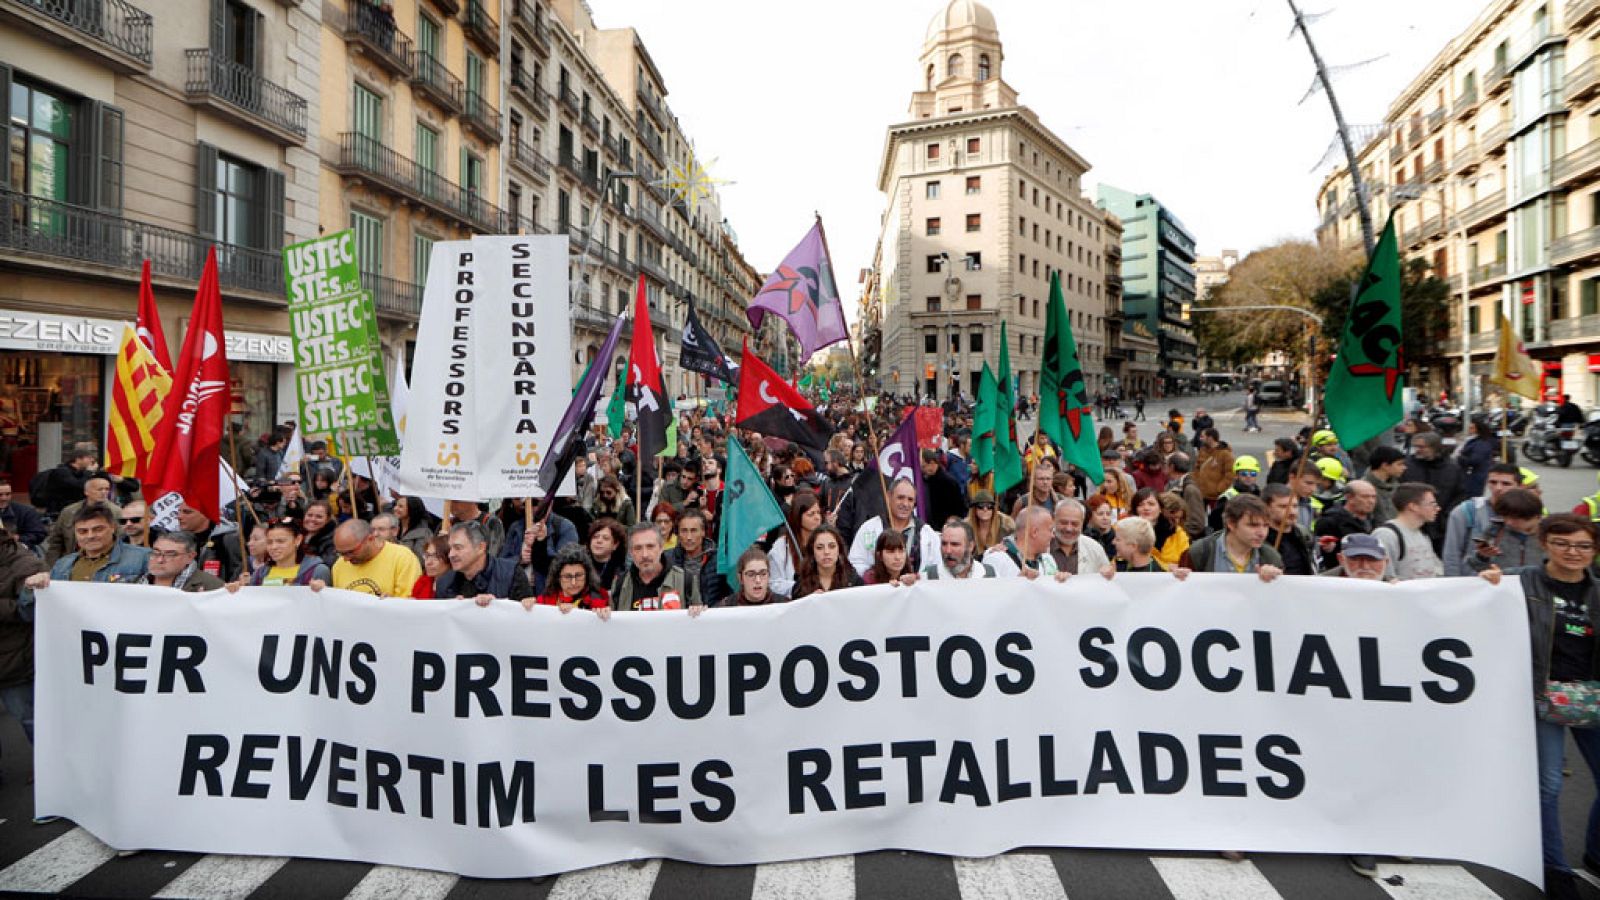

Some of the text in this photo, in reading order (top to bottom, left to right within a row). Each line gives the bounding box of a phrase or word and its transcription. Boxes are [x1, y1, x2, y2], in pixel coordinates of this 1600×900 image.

[288, 234, 353, 277] USTEC
[294, 299, 362, 340] USTEC
[442, 252, 474, 434] PROFESSORS
[301, 364, 370, 403] USTEC
[80, 626, 1476, 722] PER UNS PRESSUPOSTOS SOCIALS
[178, 730, 1306, 829] REVERTIM LES RETALLADES
